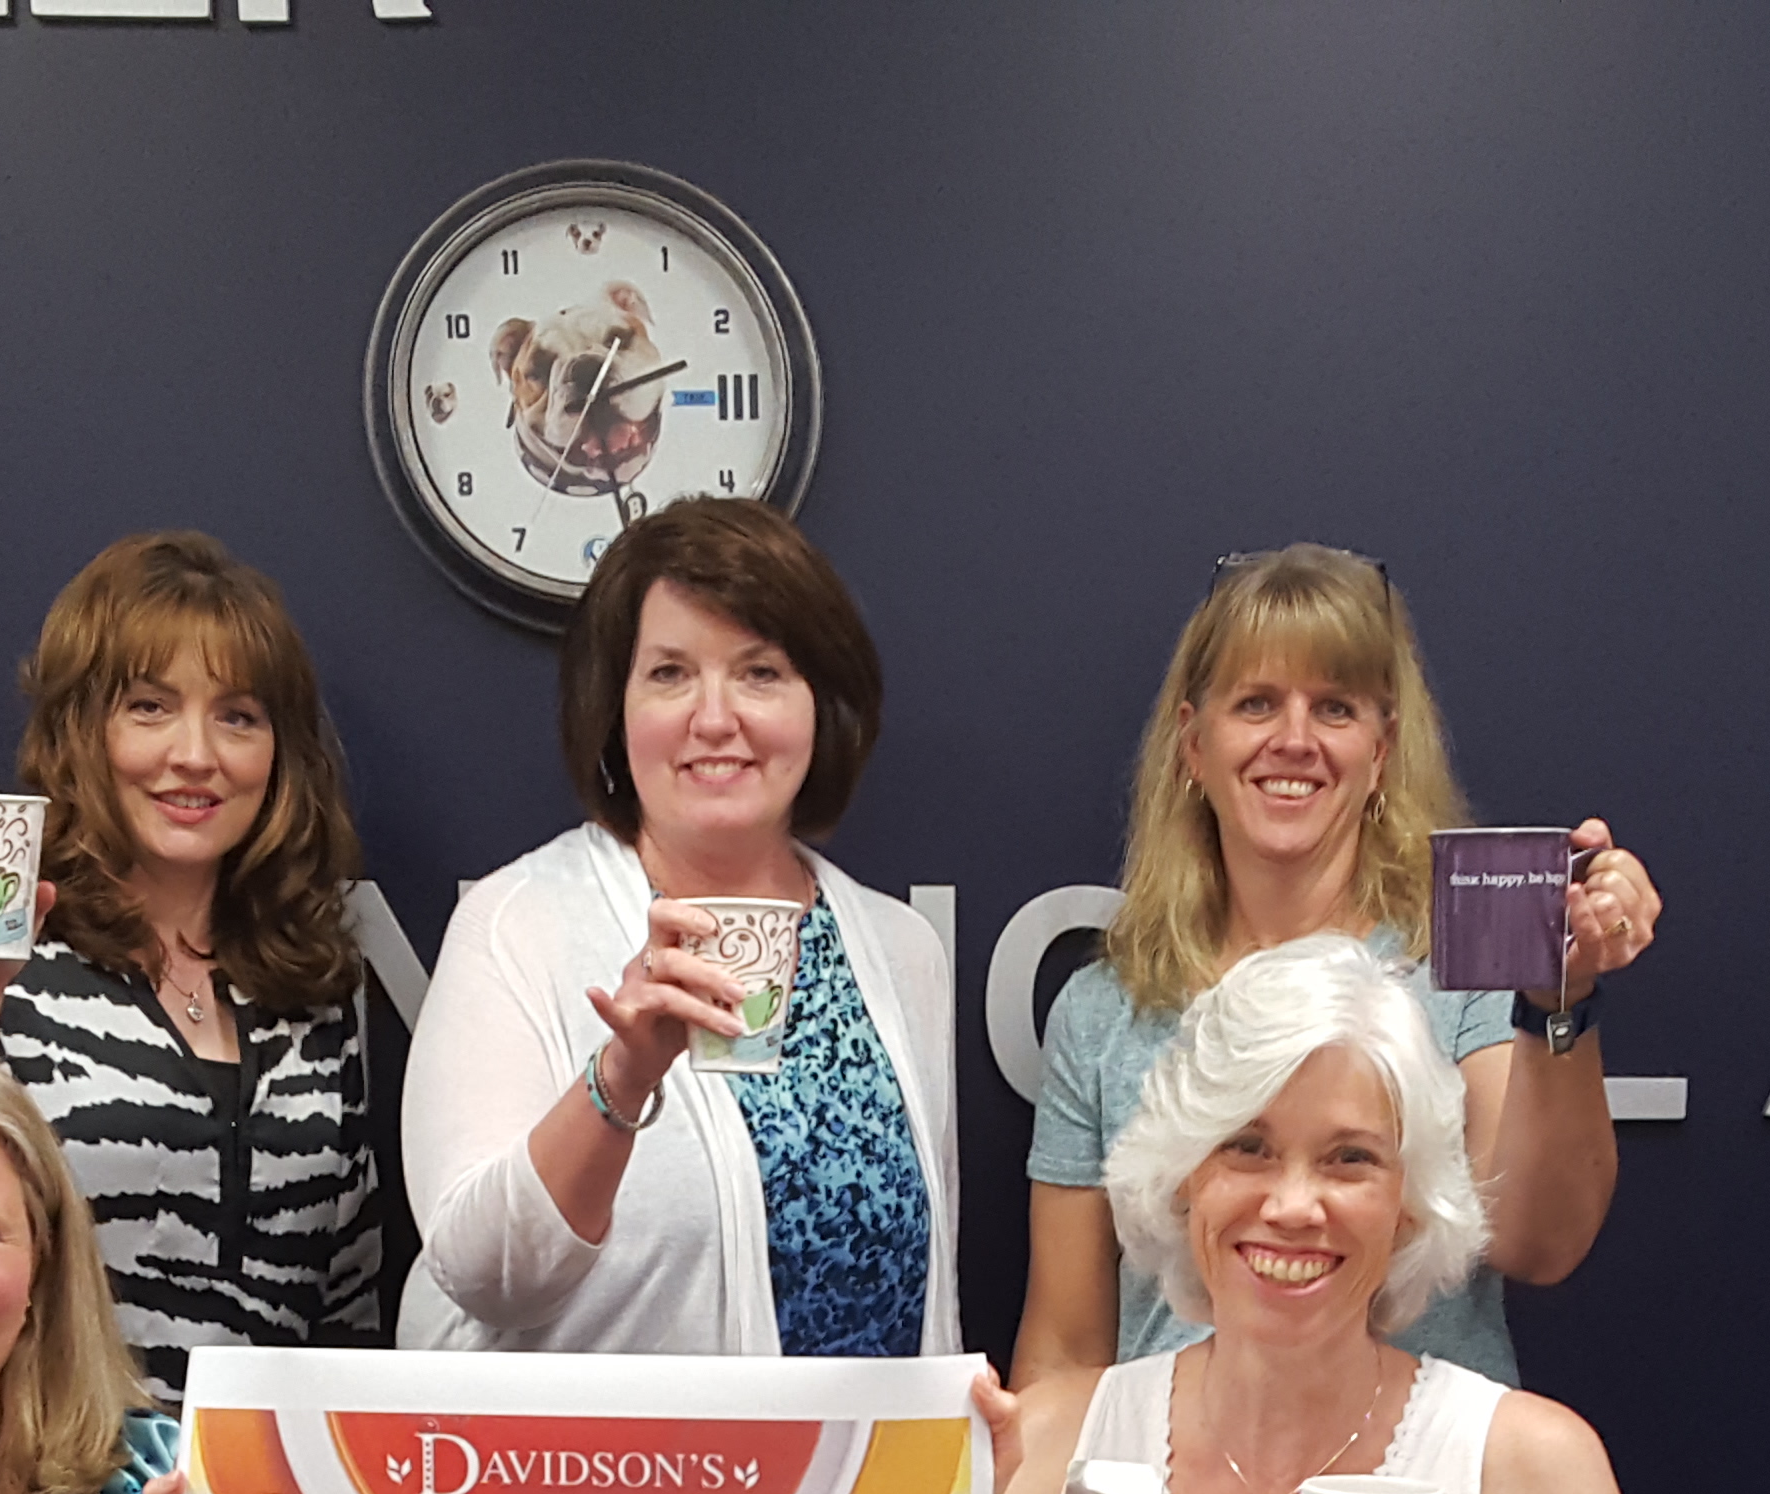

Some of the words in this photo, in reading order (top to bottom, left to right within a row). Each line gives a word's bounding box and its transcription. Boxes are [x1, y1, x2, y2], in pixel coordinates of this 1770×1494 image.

[500, 249, 520, 276] 11
[660, 245, 670, 272] 1
[445, 314, 471, 340] 10
[713, 309, 731, 335] 2
[457, 472, 474, 497] 8
[718, 469, 736, 493] 4
[511, 527, 528, 553] 7
